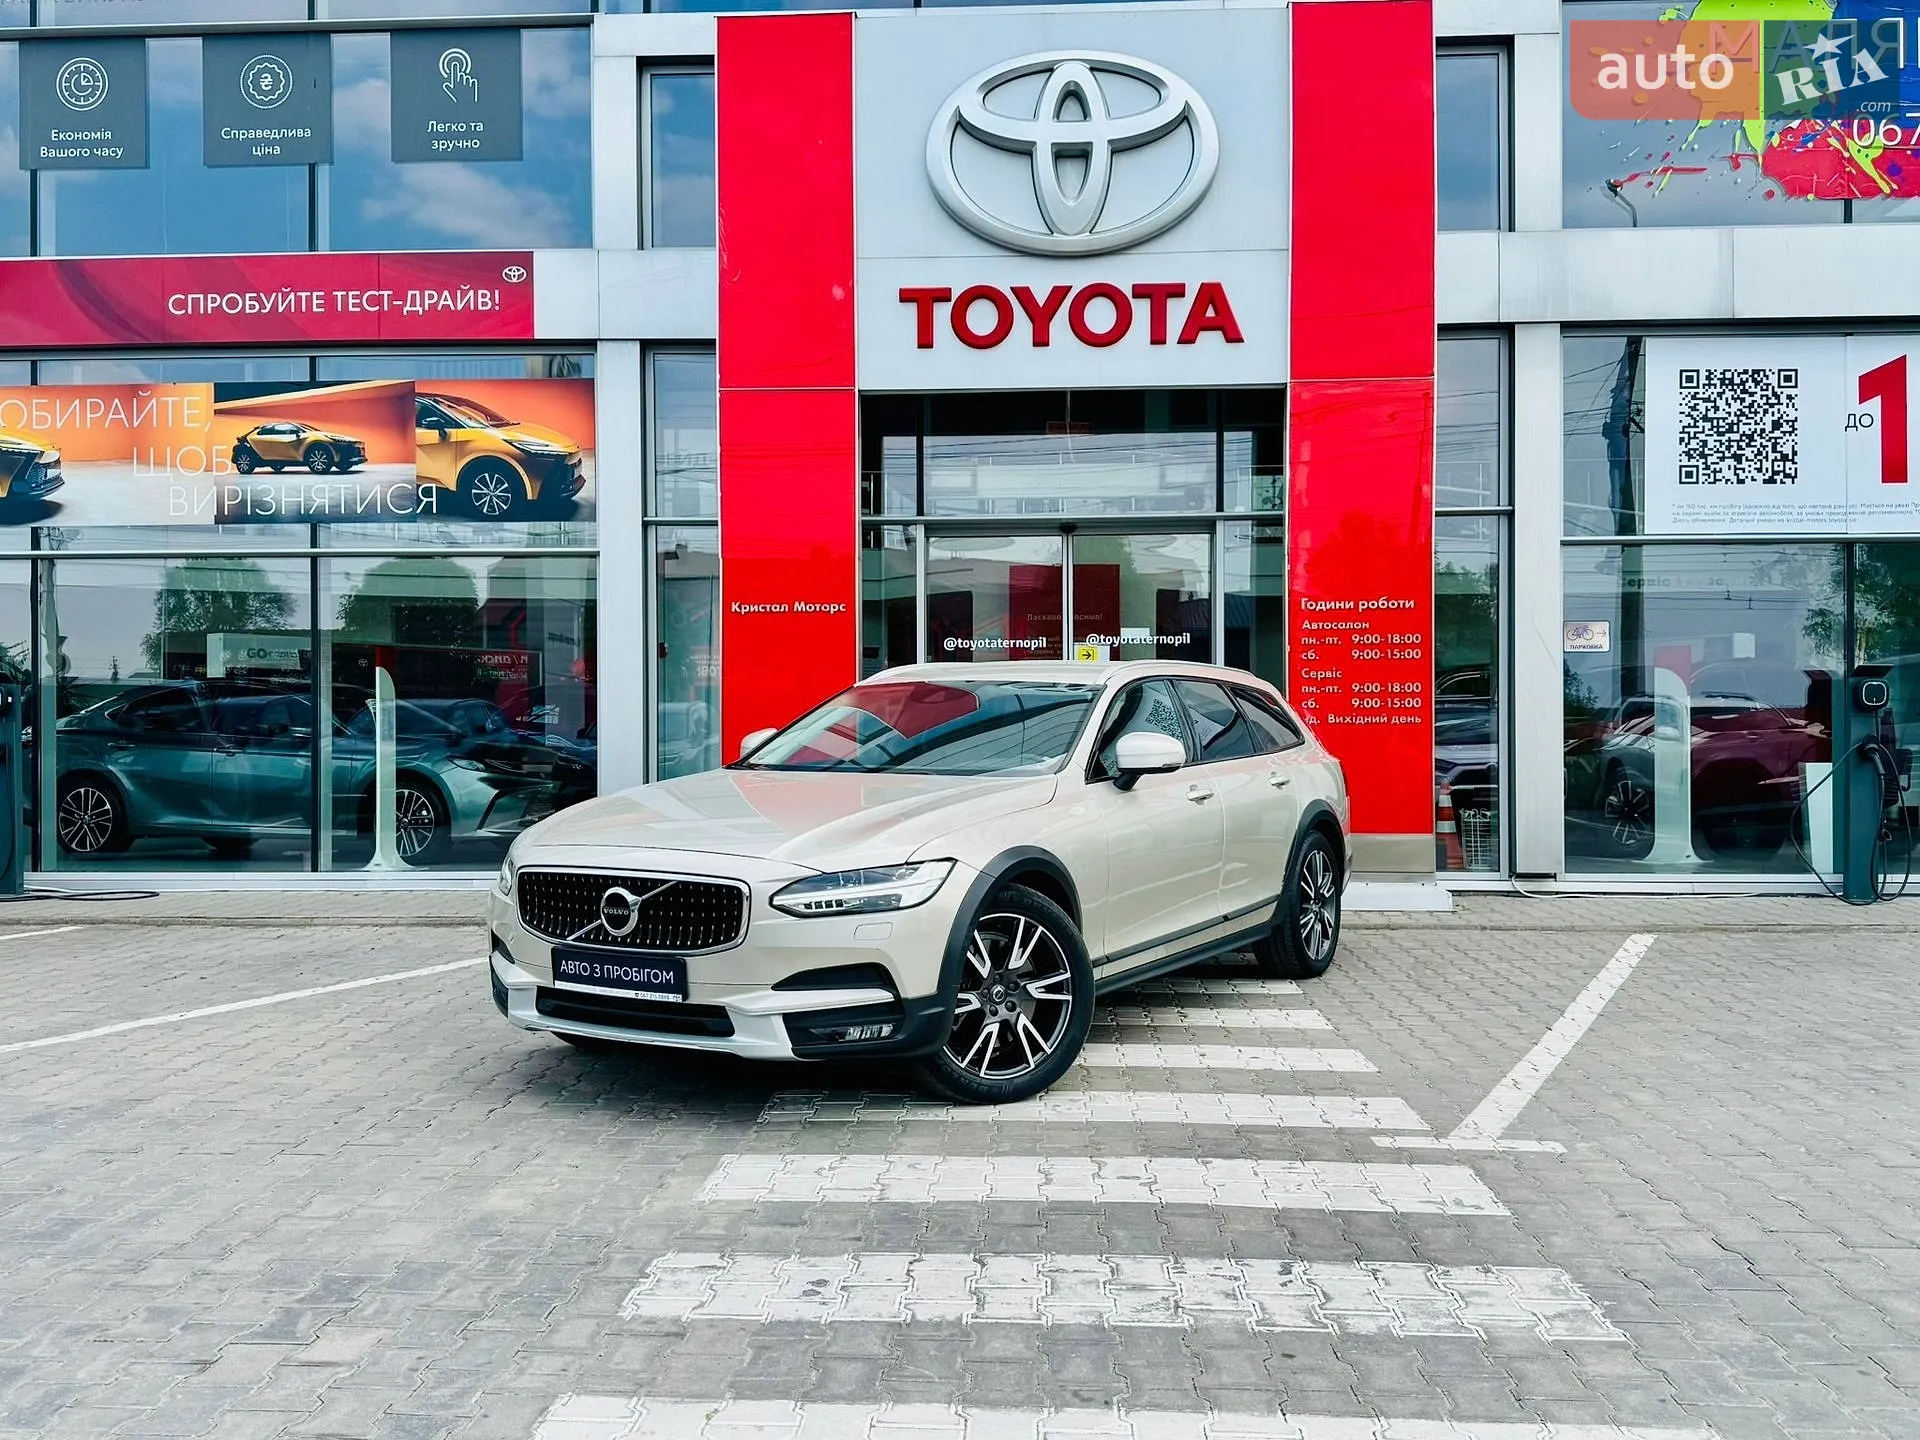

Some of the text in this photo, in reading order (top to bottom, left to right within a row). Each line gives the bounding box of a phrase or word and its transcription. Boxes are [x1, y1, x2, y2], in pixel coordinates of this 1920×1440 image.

[1710, 17, 1920, 74] МАЛЯ
[221, 126, 312, 141] Справедлива
[427, 120, 484, 134] Легко та
[51, 129, 112, 141] Економія
[252, 143, 281, 157] ціна
[431, 138, 481, 151] зручно
[40, 146, 124, 159] Вашого часу
[168, 285, 501, 315] СПРОБУЙТЕ ТЕСТ-ДРАЙВ!
[899, 282, 1245, 350] TOYOTA
[0, 390, 212, 432] ОБИРАЙТЕ,
[133, 445, 231, 478] ЩОБ
[169, 483, 437, 516] ВИРІЗНЯТИСЯ
[731, 601, 846, 615] Кристал Моторс
[1301, 596, 1415, 612] Години роботи
[1074, 613, 1103, 621] осимо!
[1302, 620, 1370, 630] Автосалон
[943, 637, 1047, 651] @toyotaternopil
[1086, 633, 1190, 647] @toyotaternopil
[1301, 634, 1422, 645] пн.-пт. 9:00-18:00
[1301, 649, 1422, 660] сб. 9:00-15:00
[1301, 667, 1343, 680] Сервіс
[1301, 683, 1422, 694] пн.-пт. 9:00-18:00
[1301, 698, 1422, 709] сб. 9:00-15:00
[1328, 713, 1388, 725] Вихідний
[1391, 715, 1422, 725] день
[603, 907, 629, 916] VOLVO
[560, 960, 674, 984] АВТО З ПРОБІГОМ
